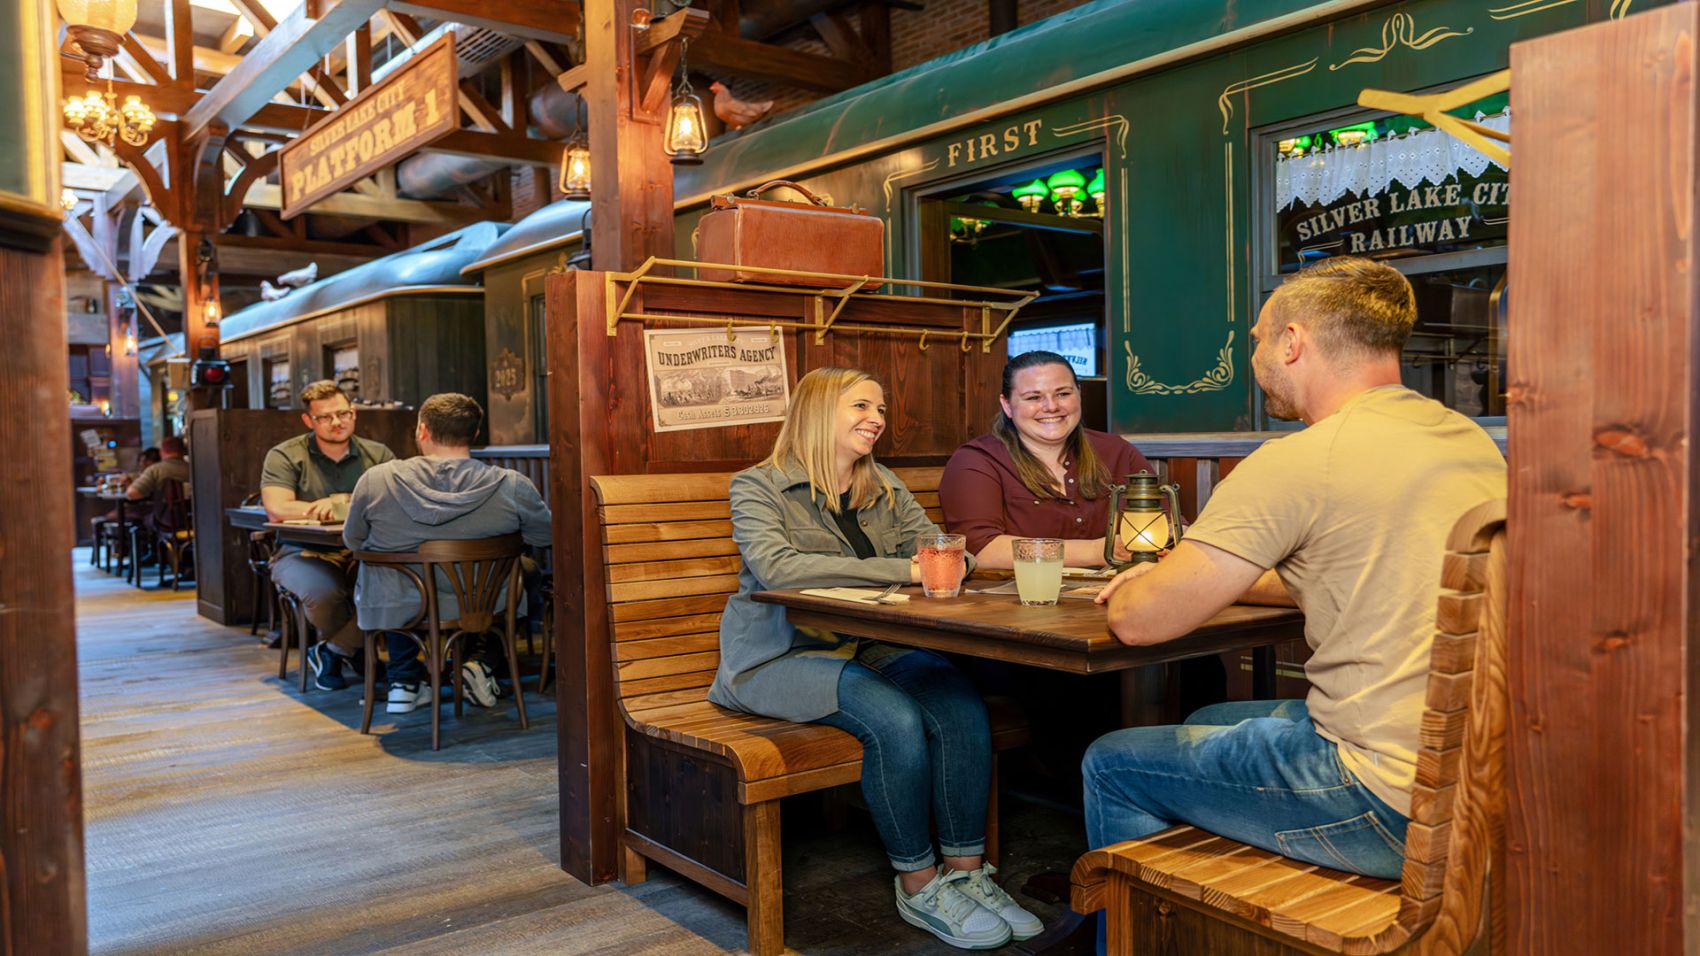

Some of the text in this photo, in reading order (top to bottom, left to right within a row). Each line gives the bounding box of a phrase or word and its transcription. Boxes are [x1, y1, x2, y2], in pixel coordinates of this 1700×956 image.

[291, 89, 440, 201] PLATFORM 1
[310, 81, 405, 156] SILVER LAKE CITY
[948, 119, 1041, 167] FIRST
[1297, 198, 1380, 241] SILVER
[1390, 183, 1461, 213] LAKE
[1351, 216, 1471, 253] RAILWAY
[658, 345, 775, 366] UNDERWRITERS AGENCY
